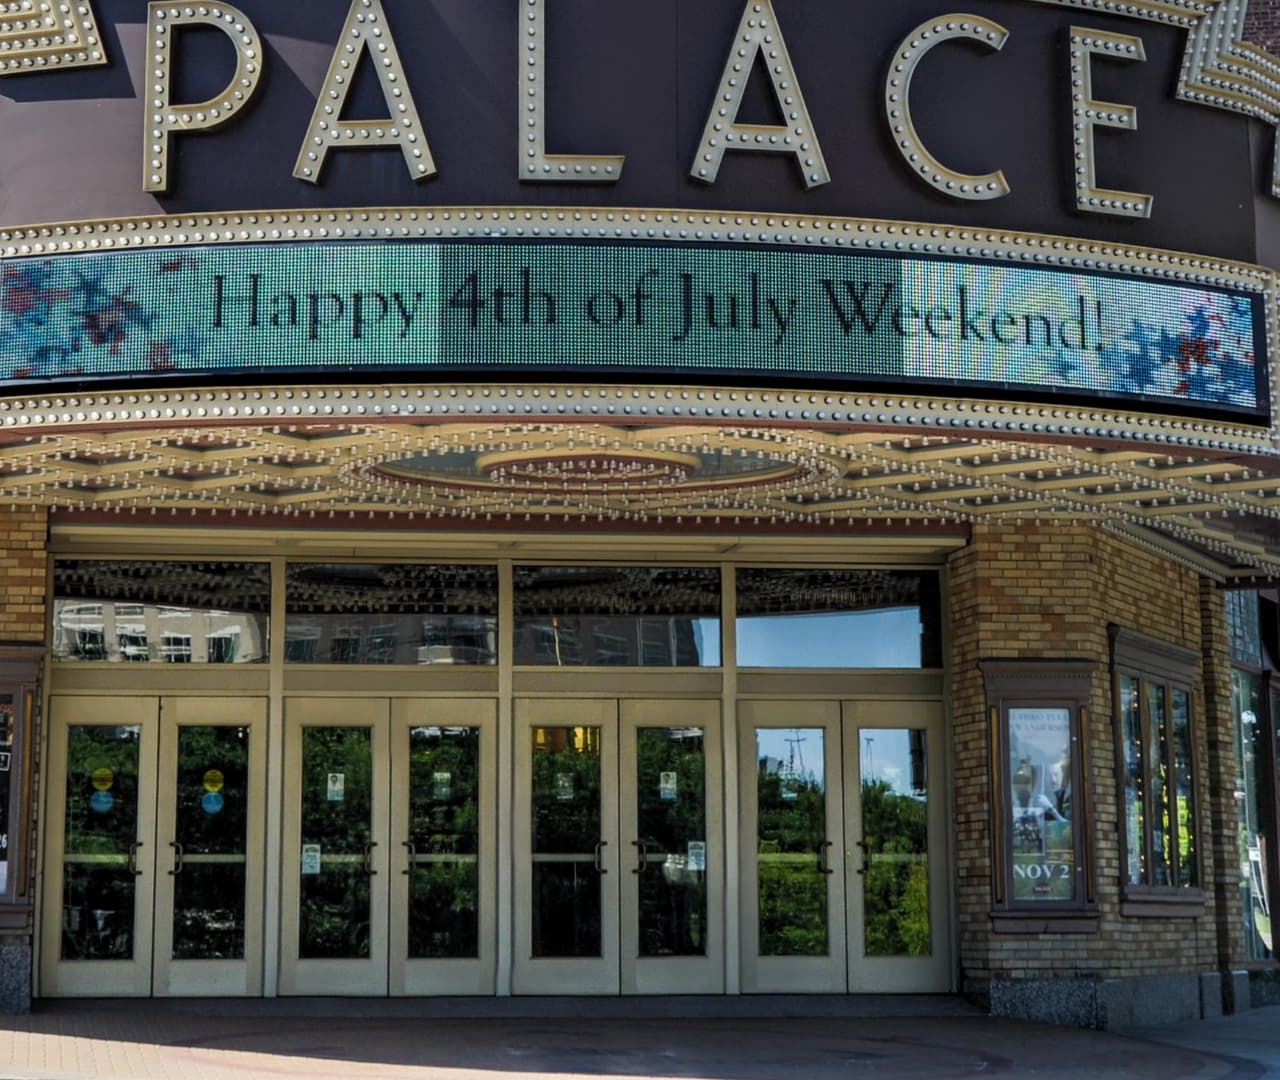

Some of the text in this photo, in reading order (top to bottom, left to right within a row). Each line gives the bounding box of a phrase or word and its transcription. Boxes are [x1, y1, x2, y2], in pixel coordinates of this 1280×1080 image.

[212, 266, 1105, 352] Happy 4th of July Weekend!
[1014, 864, 1069, 878] NOV 2
